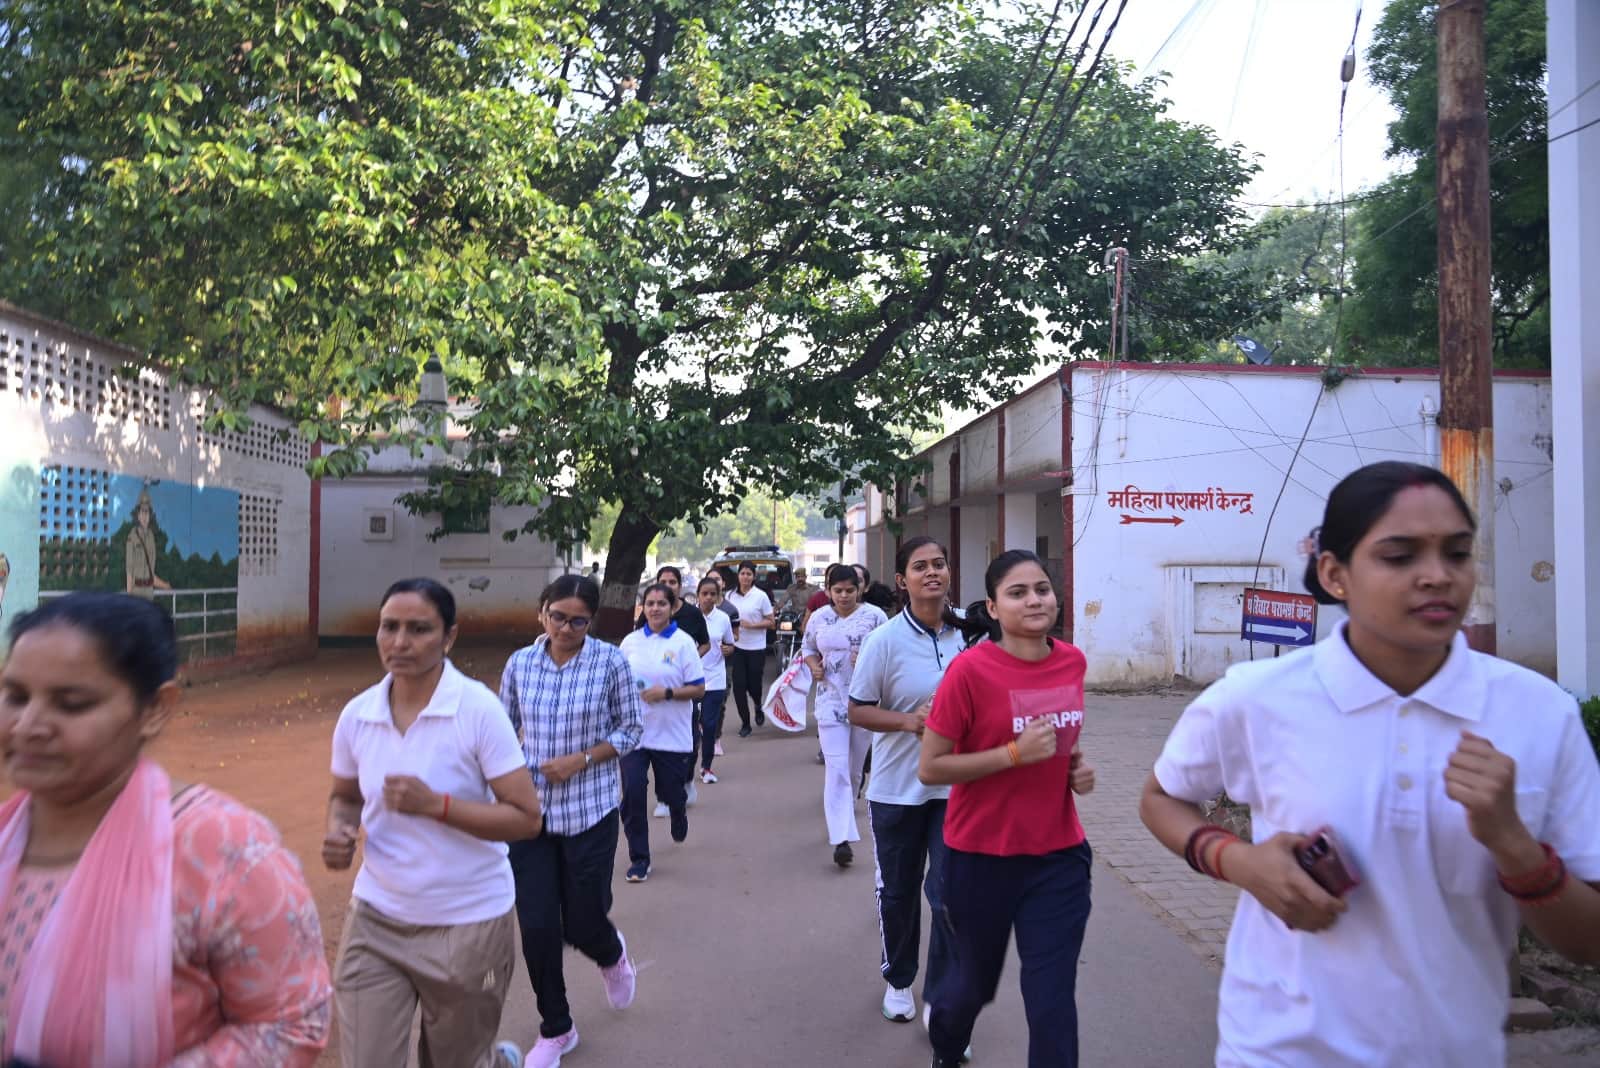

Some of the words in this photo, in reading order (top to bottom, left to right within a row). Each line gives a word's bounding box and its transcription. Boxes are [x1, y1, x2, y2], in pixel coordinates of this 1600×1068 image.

[1107, 484, 1163, 513] महिला
[1165, 486, 1215, 512] परामर्श
[1216, 487, 1254, 514] केन्द्र
[1247, 594, 1270, 616] परिवार
